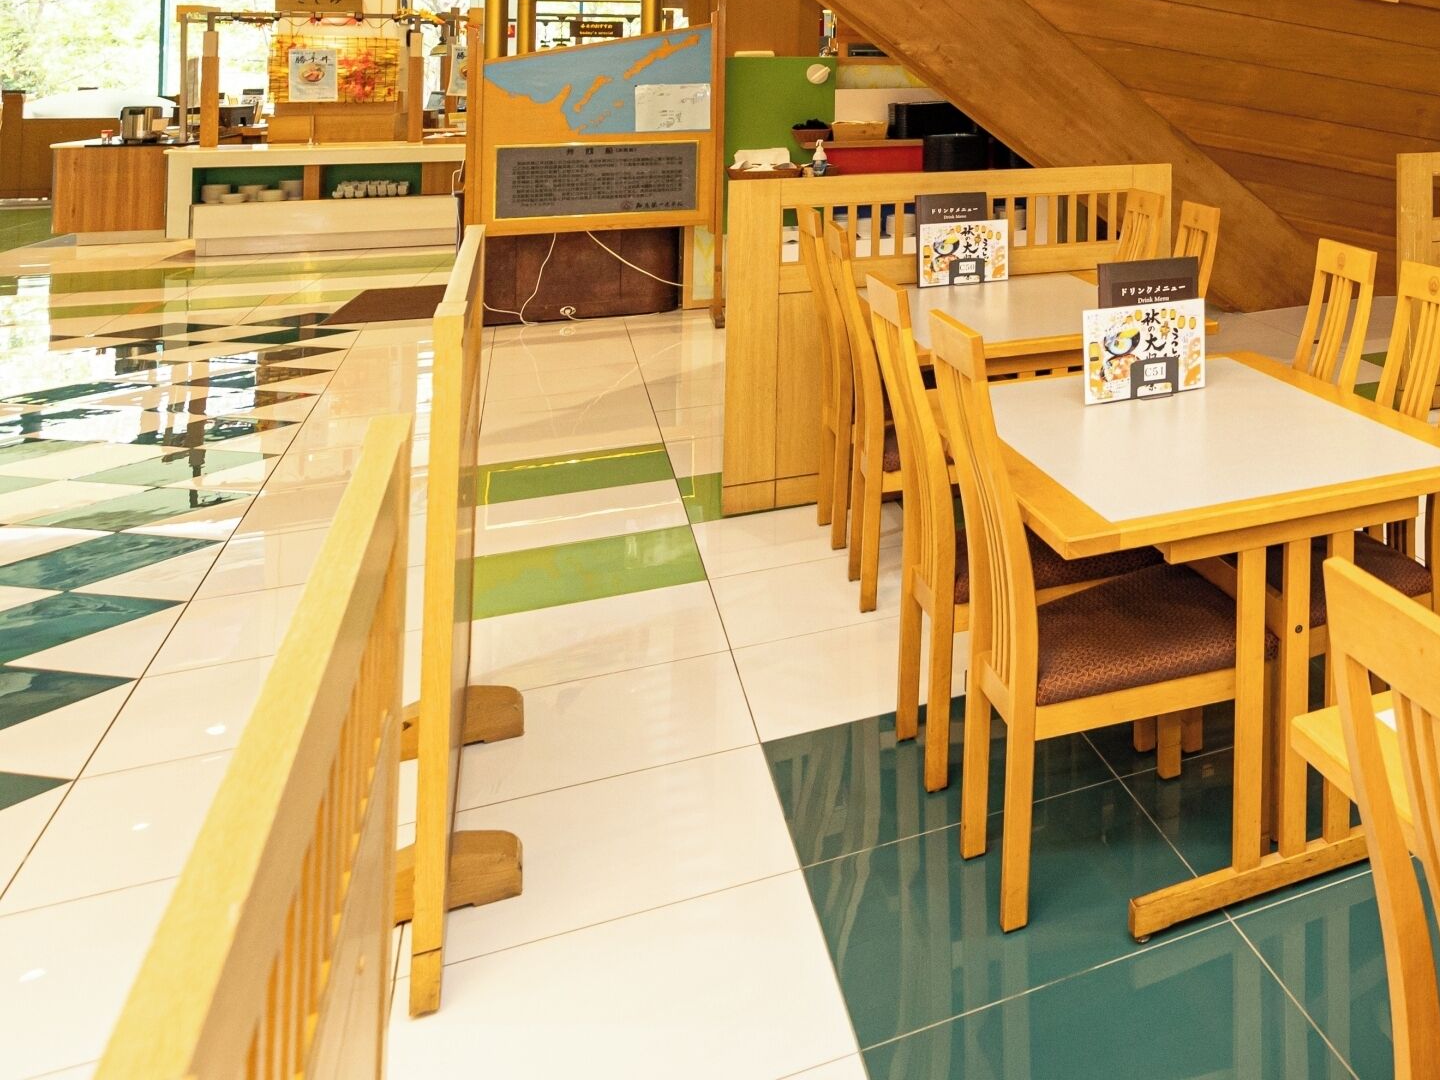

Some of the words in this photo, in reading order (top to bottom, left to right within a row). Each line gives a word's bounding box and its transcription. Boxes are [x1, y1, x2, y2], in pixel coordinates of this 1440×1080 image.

[931, 207, 979, 215] ドリンクメニュー
[1121, 284, 1186, 297] ドリンクメニュー
[1137, 296, 1153, 304] Drink
[1144, 365, 1165, 378] C51
